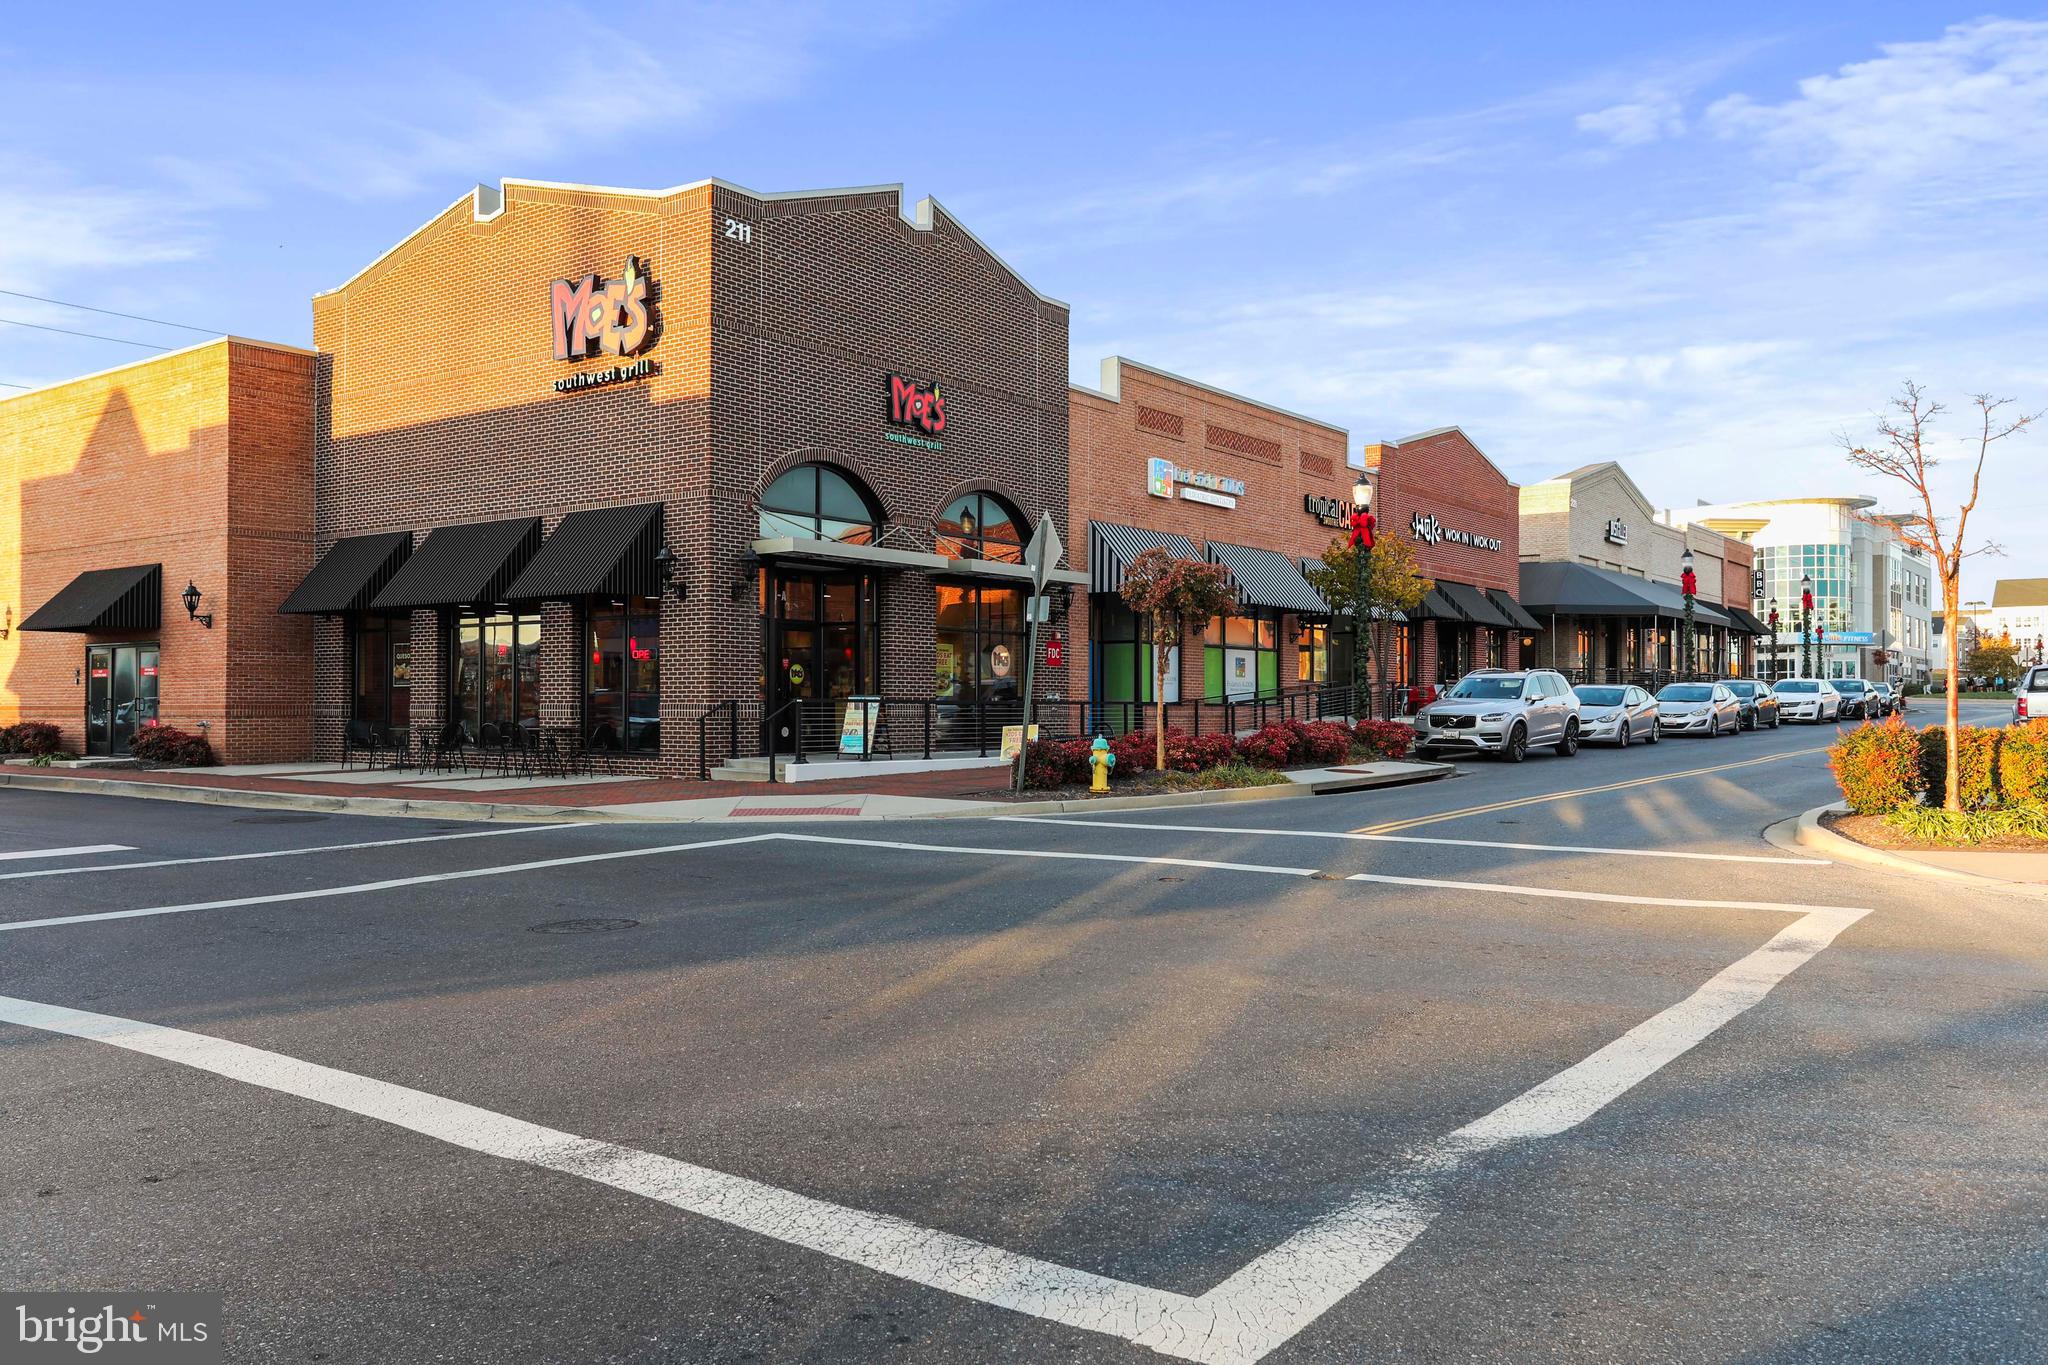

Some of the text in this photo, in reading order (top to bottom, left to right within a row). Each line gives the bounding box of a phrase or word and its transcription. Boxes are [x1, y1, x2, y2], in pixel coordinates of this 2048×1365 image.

[725, 219, 750, 244] 211
[552, 359, 649, 391] southwest grill
[885, 433, 924, 446] southwest
[1308, 494, 1338, 519] tropical
[1445, 528, 1502, 551] WOK IN WOK OUT
[1756, 571, 1764, 597] BBQ
[1047, 648, 1060, 659] FDC
